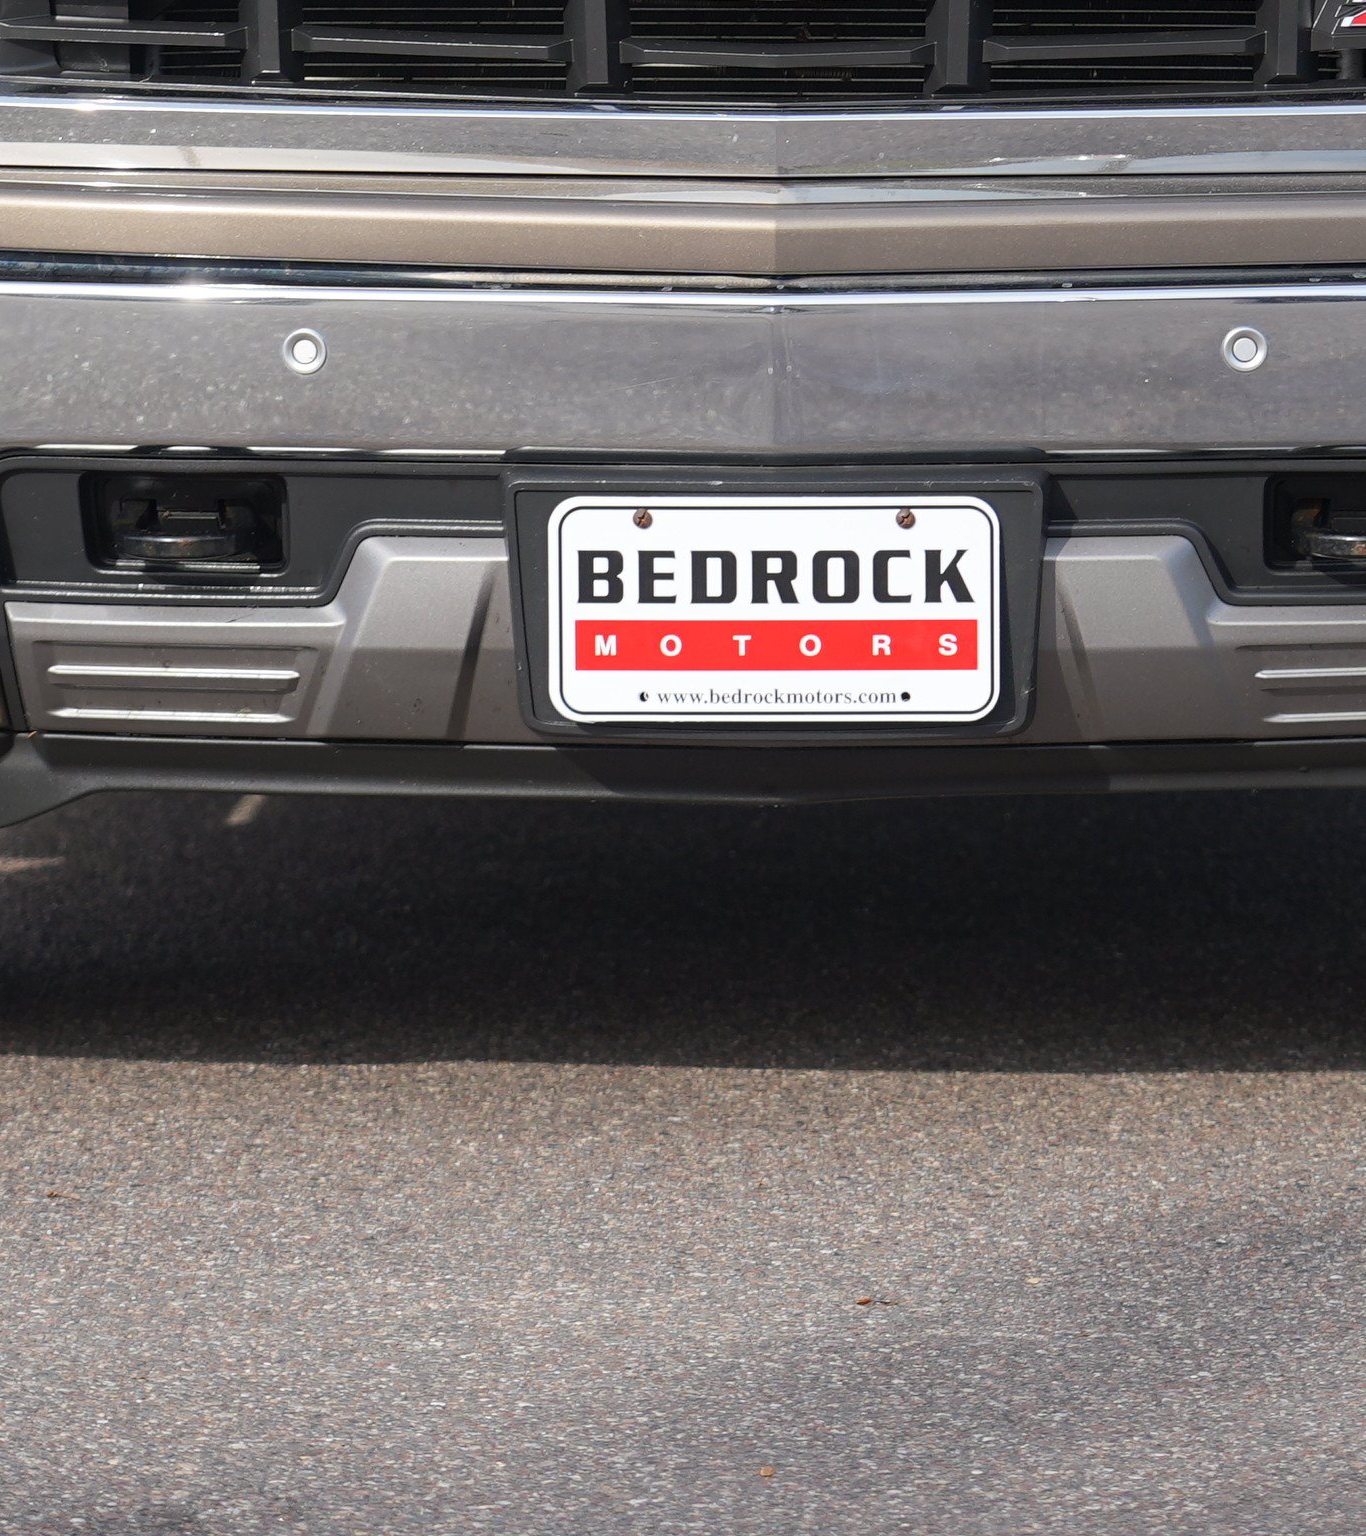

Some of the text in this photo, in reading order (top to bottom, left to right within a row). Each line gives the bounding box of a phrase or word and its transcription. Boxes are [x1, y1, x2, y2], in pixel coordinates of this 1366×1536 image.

[577, 549, 975, 604] BEDROCK
[594, 634, 958, 657] MOTORS
[657, 688, 897, 706] www.bedrockmotors.com
